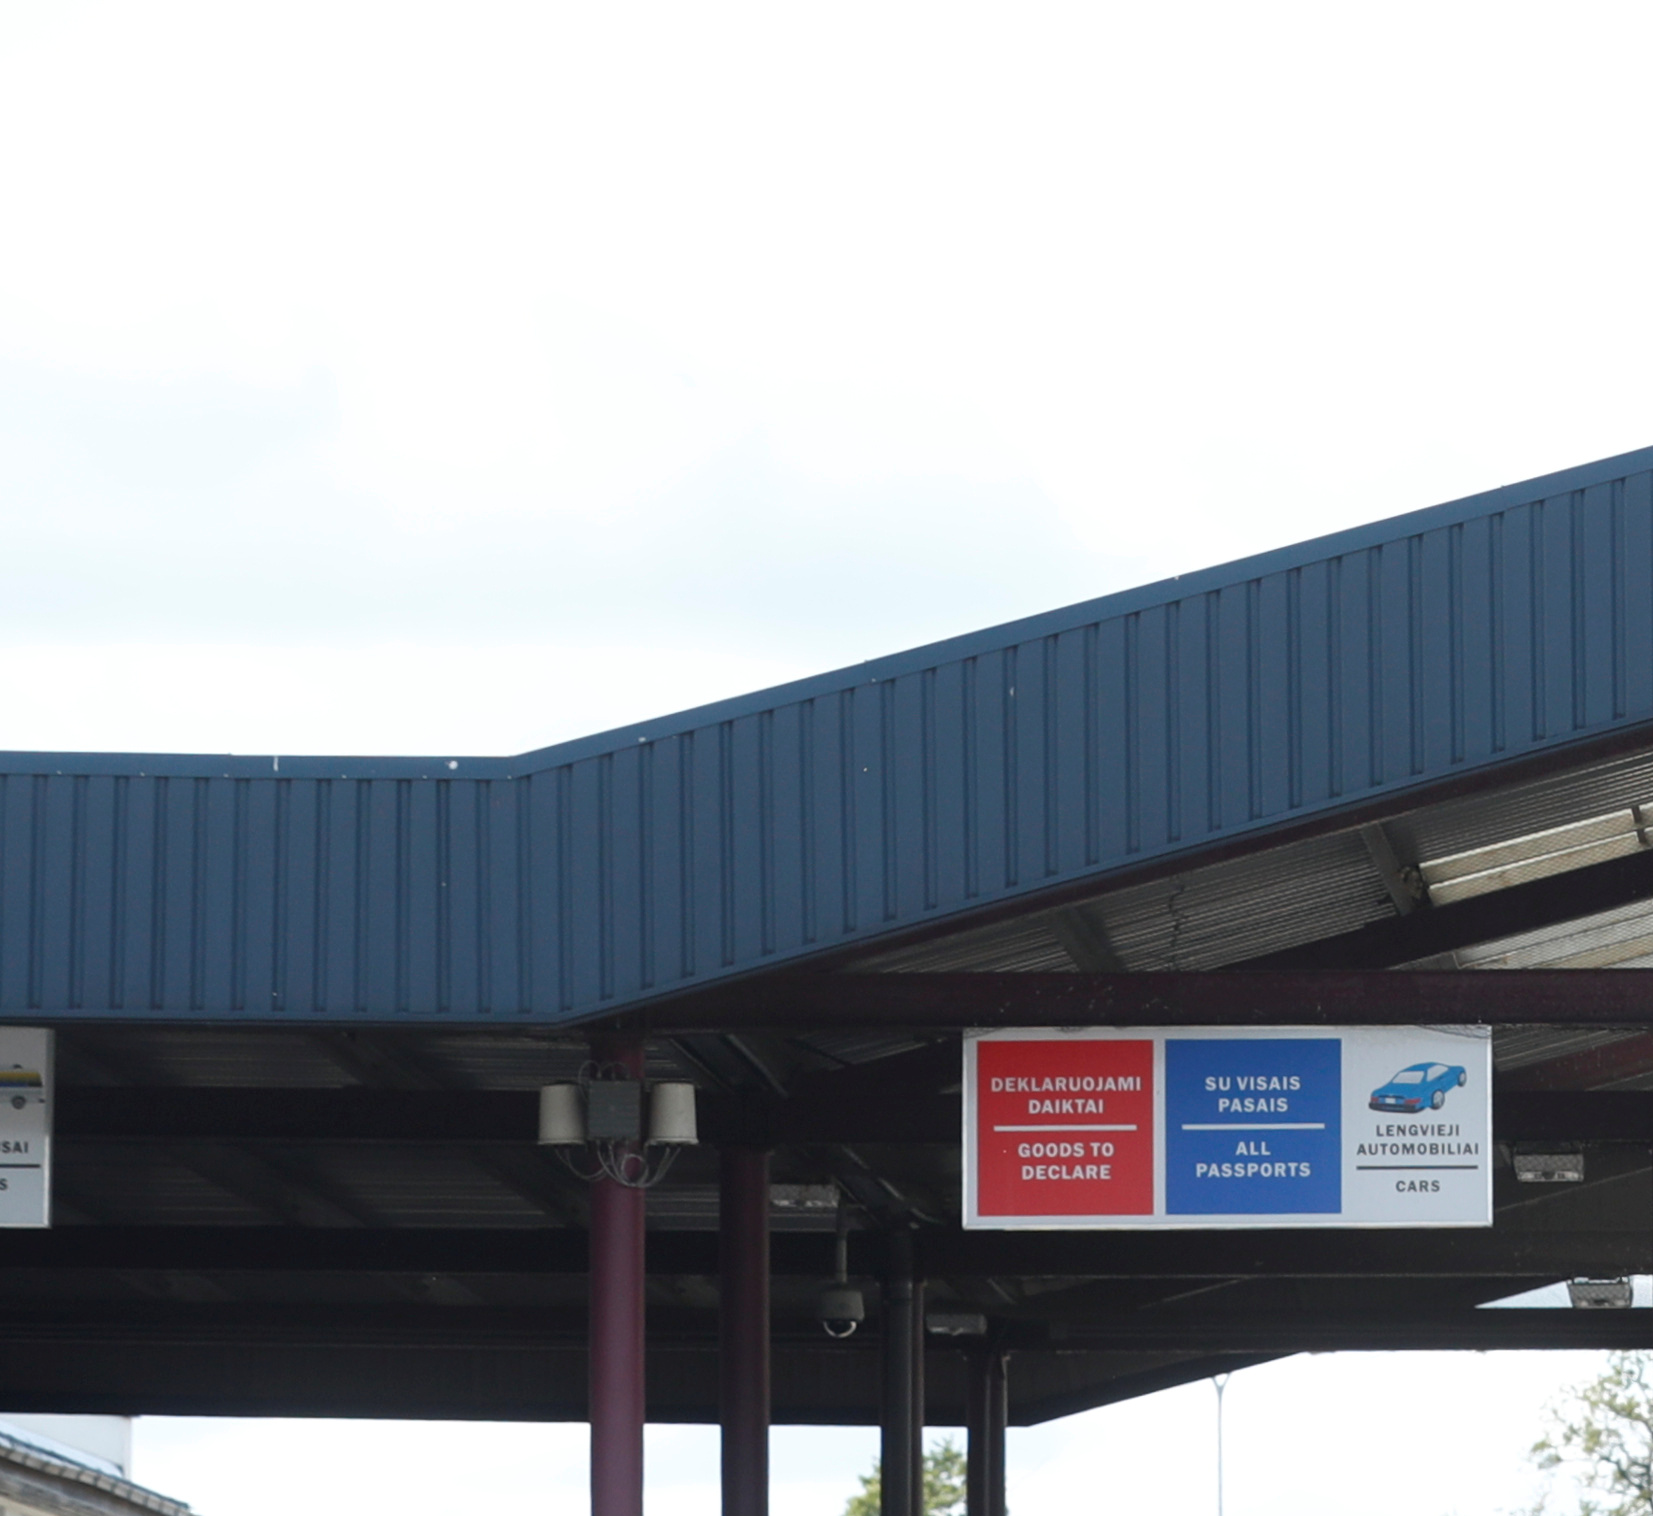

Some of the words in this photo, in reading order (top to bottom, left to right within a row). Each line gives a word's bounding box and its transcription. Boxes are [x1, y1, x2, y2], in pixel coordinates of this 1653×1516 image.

[992, 1077, 1140, 1091] DEKLARUOJAMI
[1206, 1077, 1230, 1091] SU
[1237, 1076, 1300, 1090] VISAIS
[1029, 1099, 1103, 1114] DAIKTAI
[1219, 1098, 1288, 1112] PASAIS
[1376, 1124, 1459, 1137] LENGVIEJI
[1018, 1143, 1084, 1157] GOODS
[1091, 1143, 1114, 1156] TO
[1236, 1142, 1270, 1155] ALL
[1357, 1143, 1478, 1155] AUTOMOBILIAI
[1022, 1165, 1110, 1180] DECLARE
[1197, 1163, 1310, 1177] PASSPORTS
[1396, 1180, 1440, 1192] CARS
